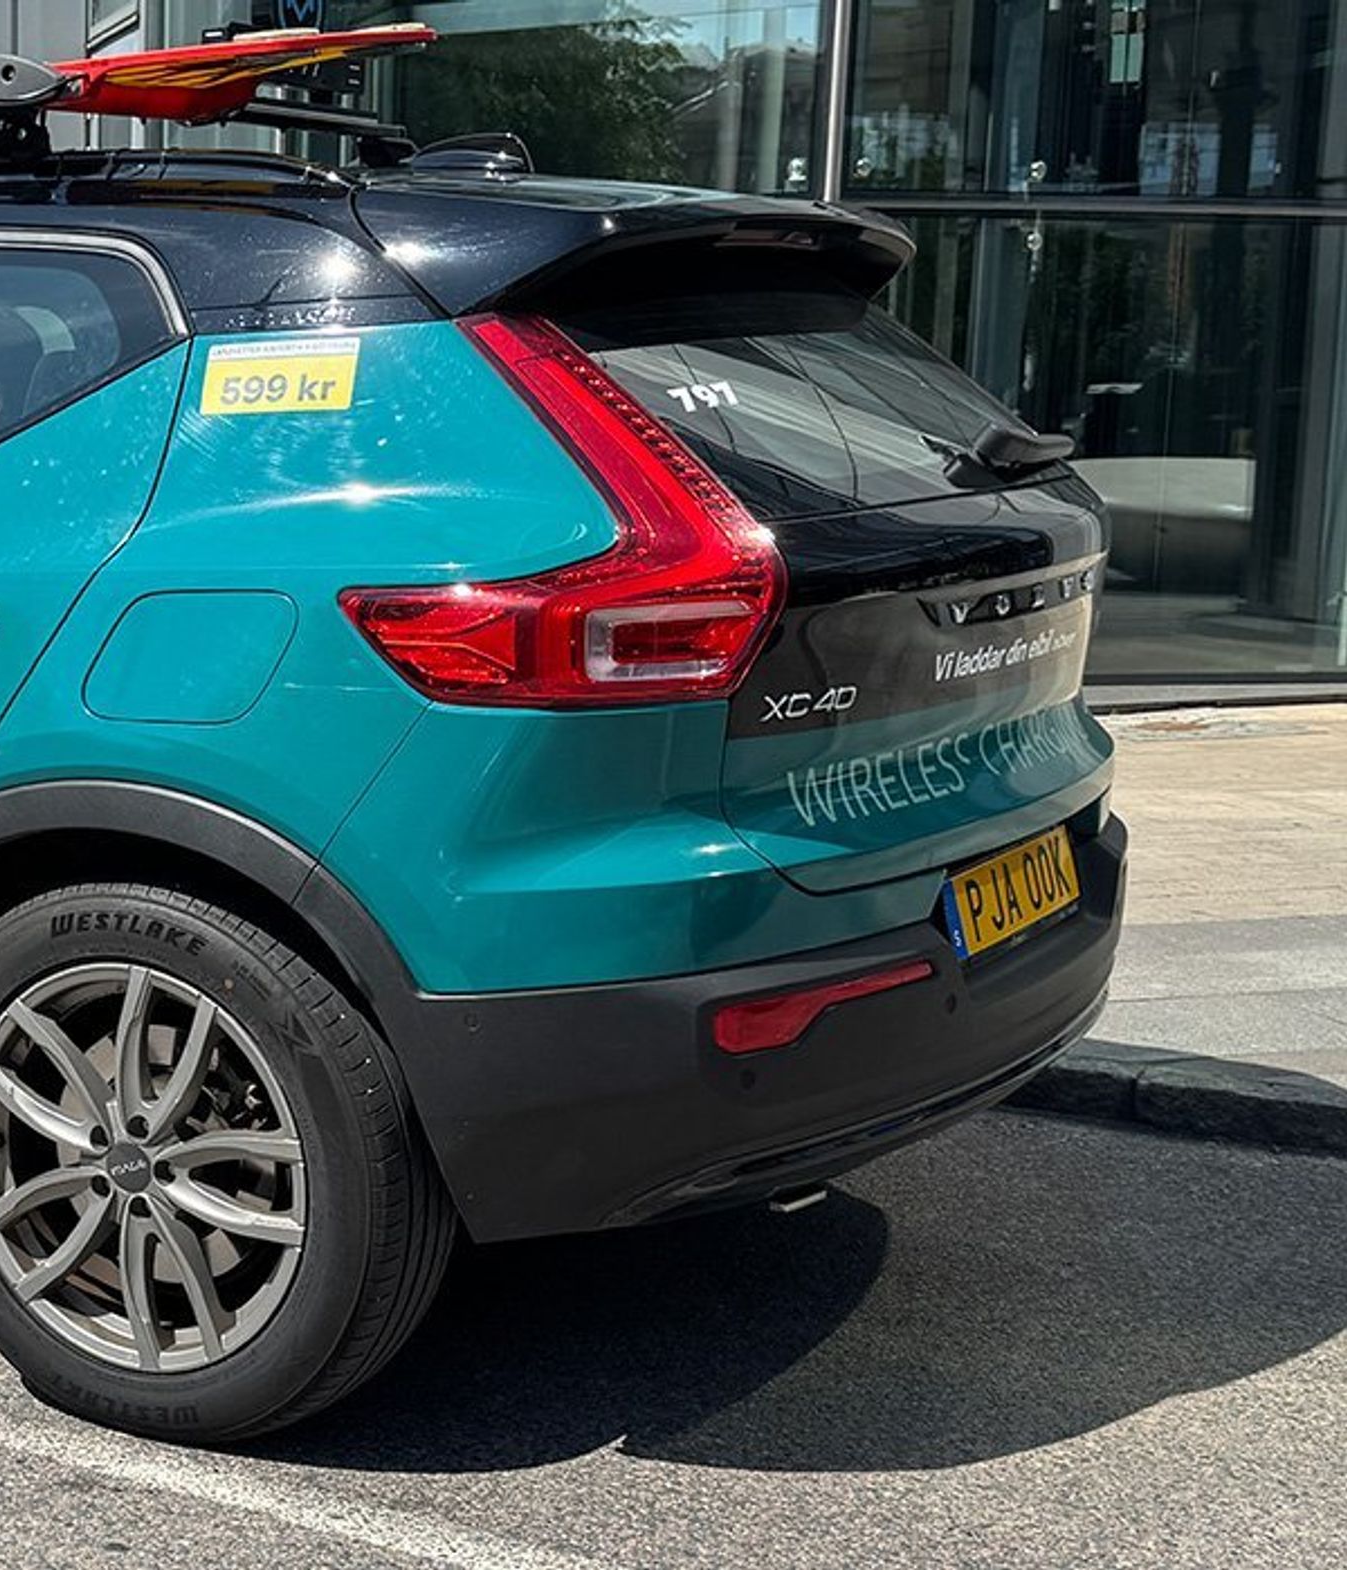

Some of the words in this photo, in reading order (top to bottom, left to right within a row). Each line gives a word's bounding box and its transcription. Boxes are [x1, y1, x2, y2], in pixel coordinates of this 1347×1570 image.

[221, 374, 289, 405] 599
[298, 374, 337, 401] kr
[666, 381, 738, 412] 797
[935, 652, 955, 681] Vi
[953, 645, 1006, 678] laddar
[1006, 637, 1028, 666] din
[965, 863, 1023, 942] PJA
[51, 912, 209, 956] WESTLAKE
